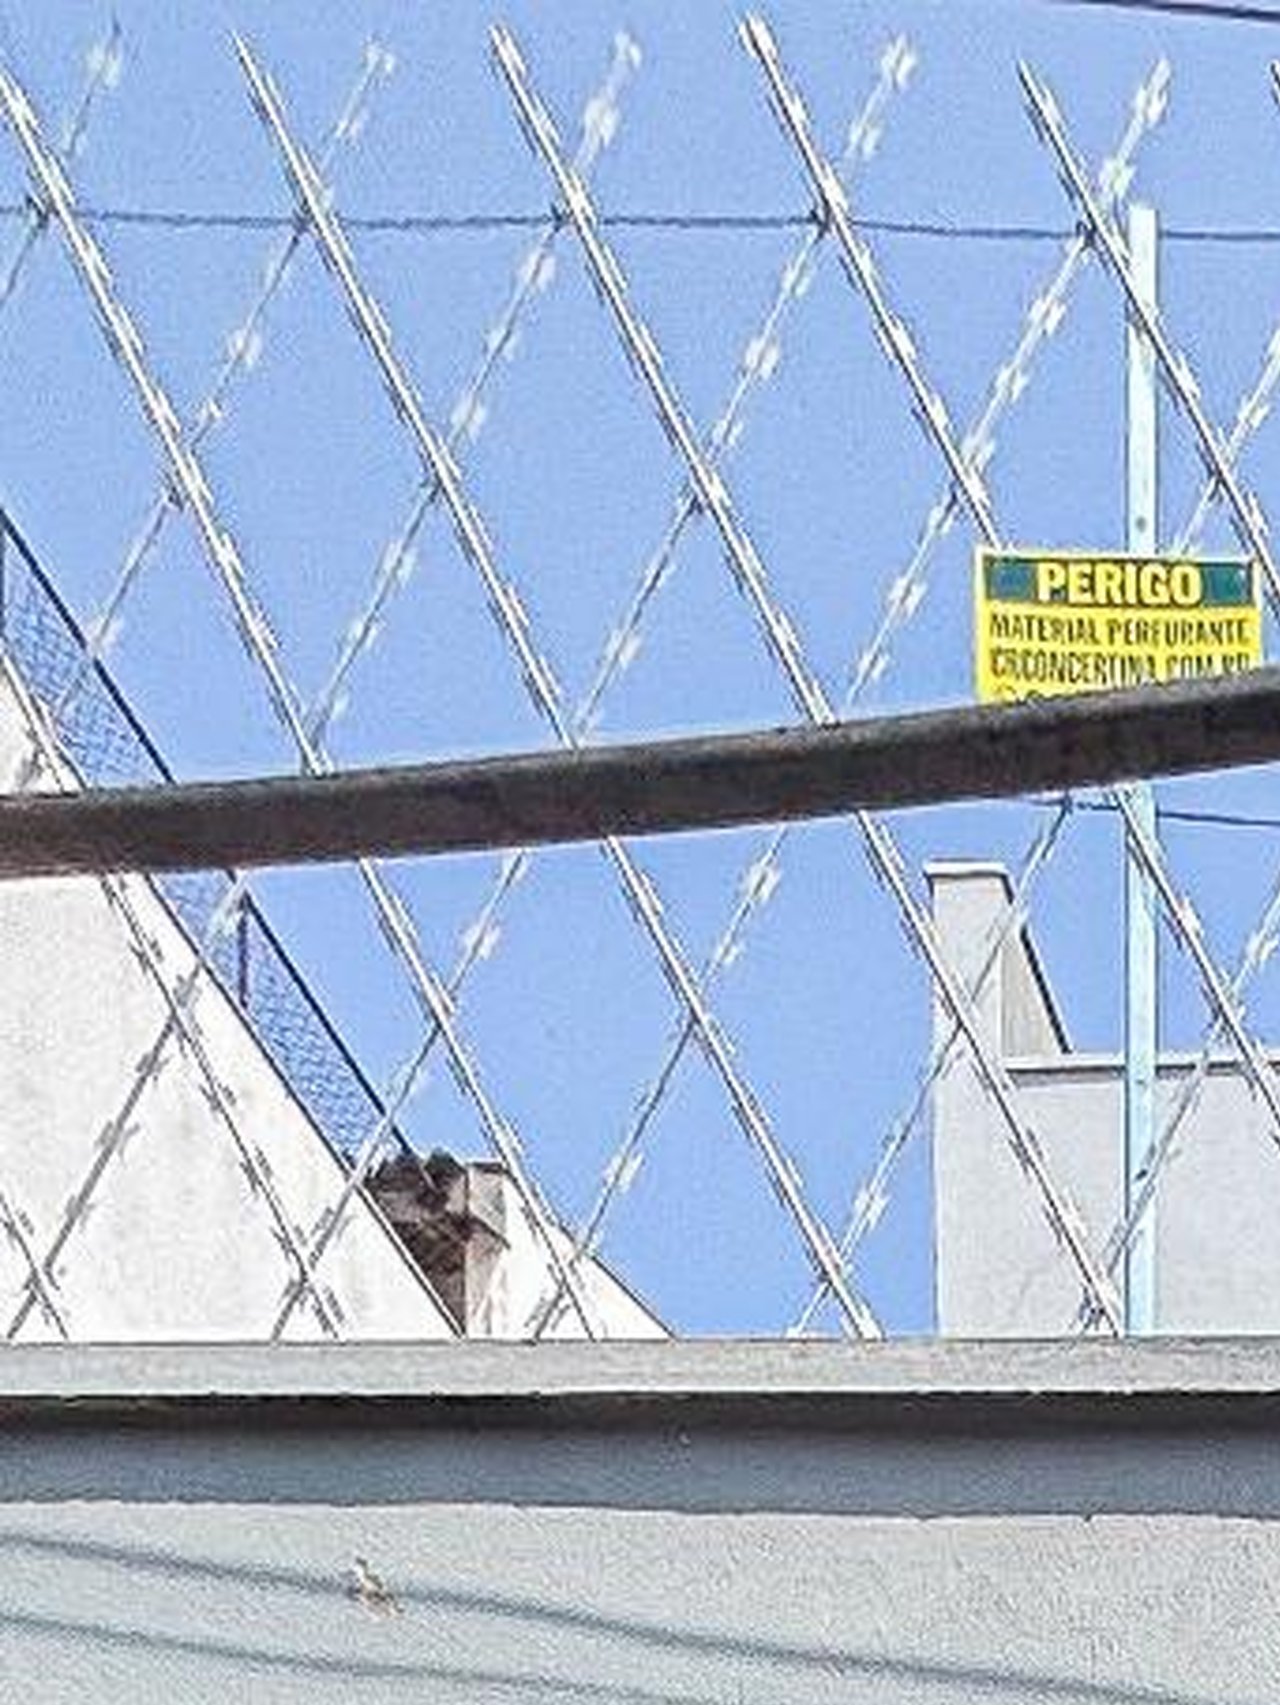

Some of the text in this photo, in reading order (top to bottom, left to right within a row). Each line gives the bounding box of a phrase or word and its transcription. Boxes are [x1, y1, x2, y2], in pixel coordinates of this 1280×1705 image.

[1036, 561, 1203, 606] PERIGO
[990, 613, 1252, 646] MATERIAL PERFURANTE
